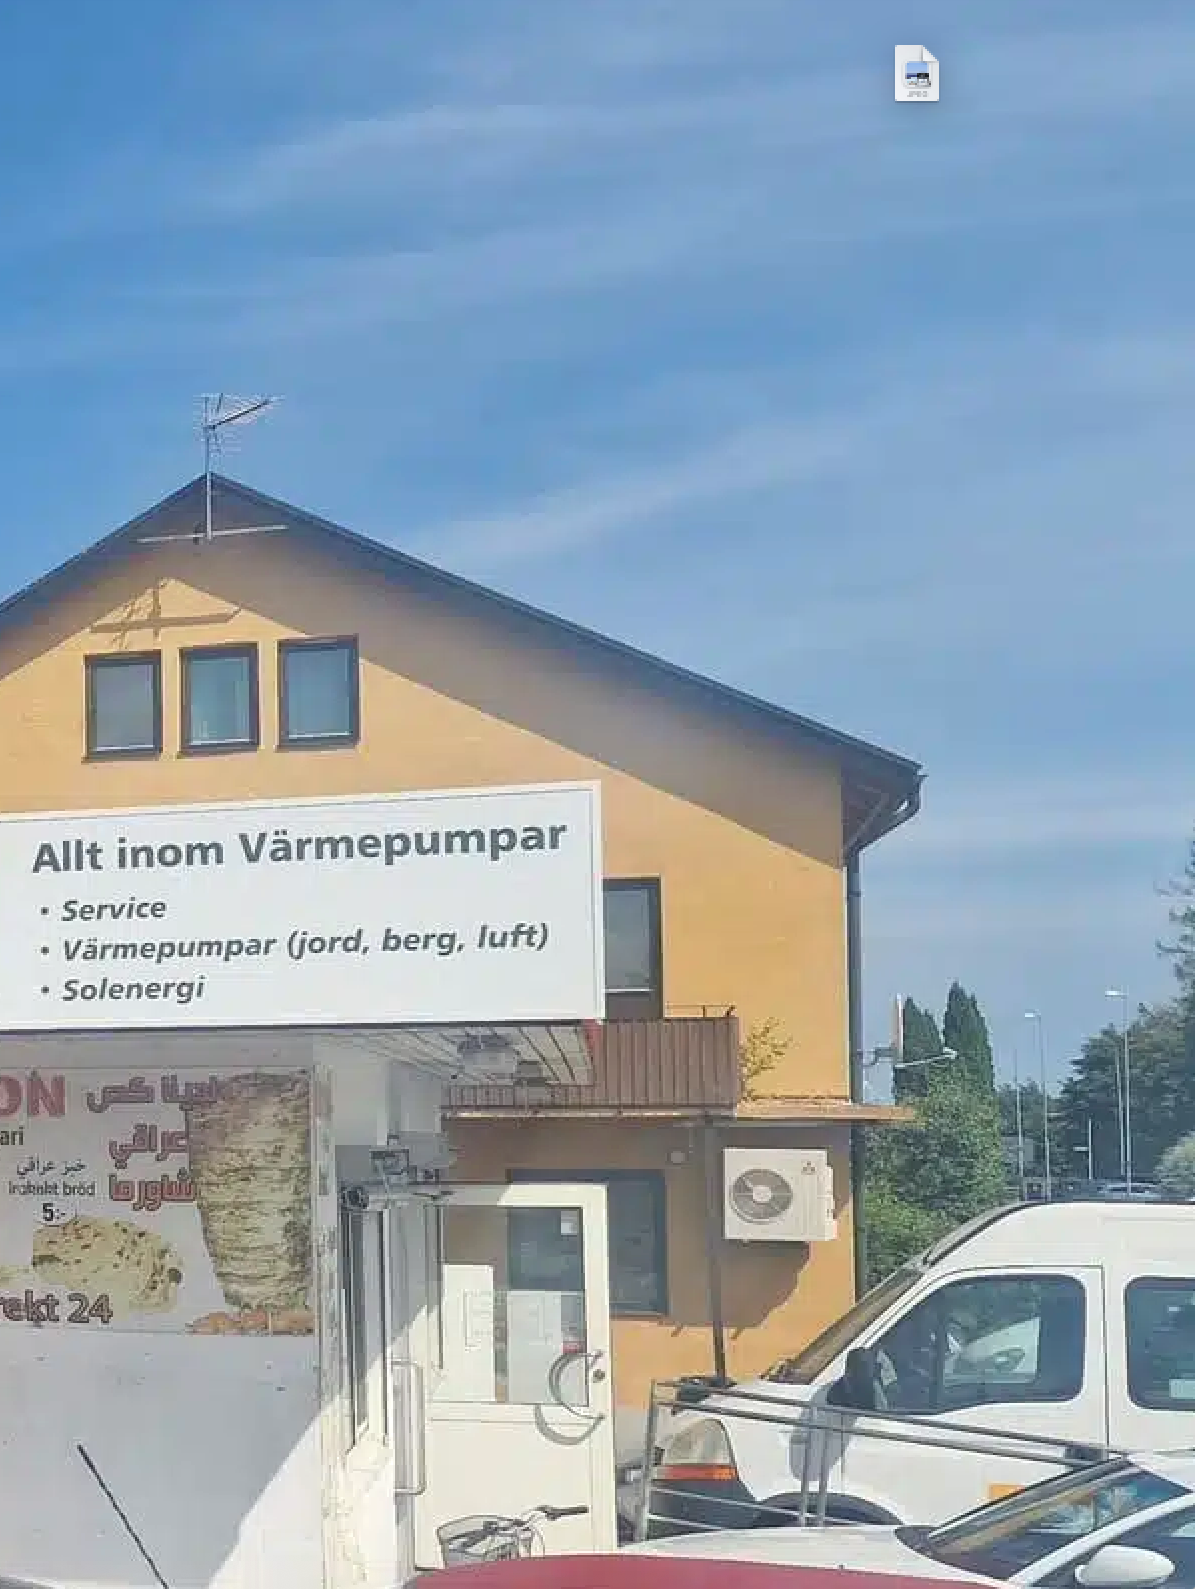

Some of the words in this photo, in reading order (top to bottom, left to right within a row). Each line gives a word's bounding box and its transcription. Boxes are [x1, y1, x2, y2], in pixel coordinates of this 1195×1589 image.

[31, 839, 104, 873] Allt
[116, 837, 224, 871] inom
[238, 822, 568, 866] Värmepumpar
[61, 896, 167, 922] Service
[62, 934, 277, 964] Värmepumpar
[287, 929, 370, 964] (jord,
[382, 926, 465, 957] berg,
[476, 921, 548, 951] luft)
[61, 975, 205, 1005] Solenergi
[66, 1292, 114, 1324] 24
